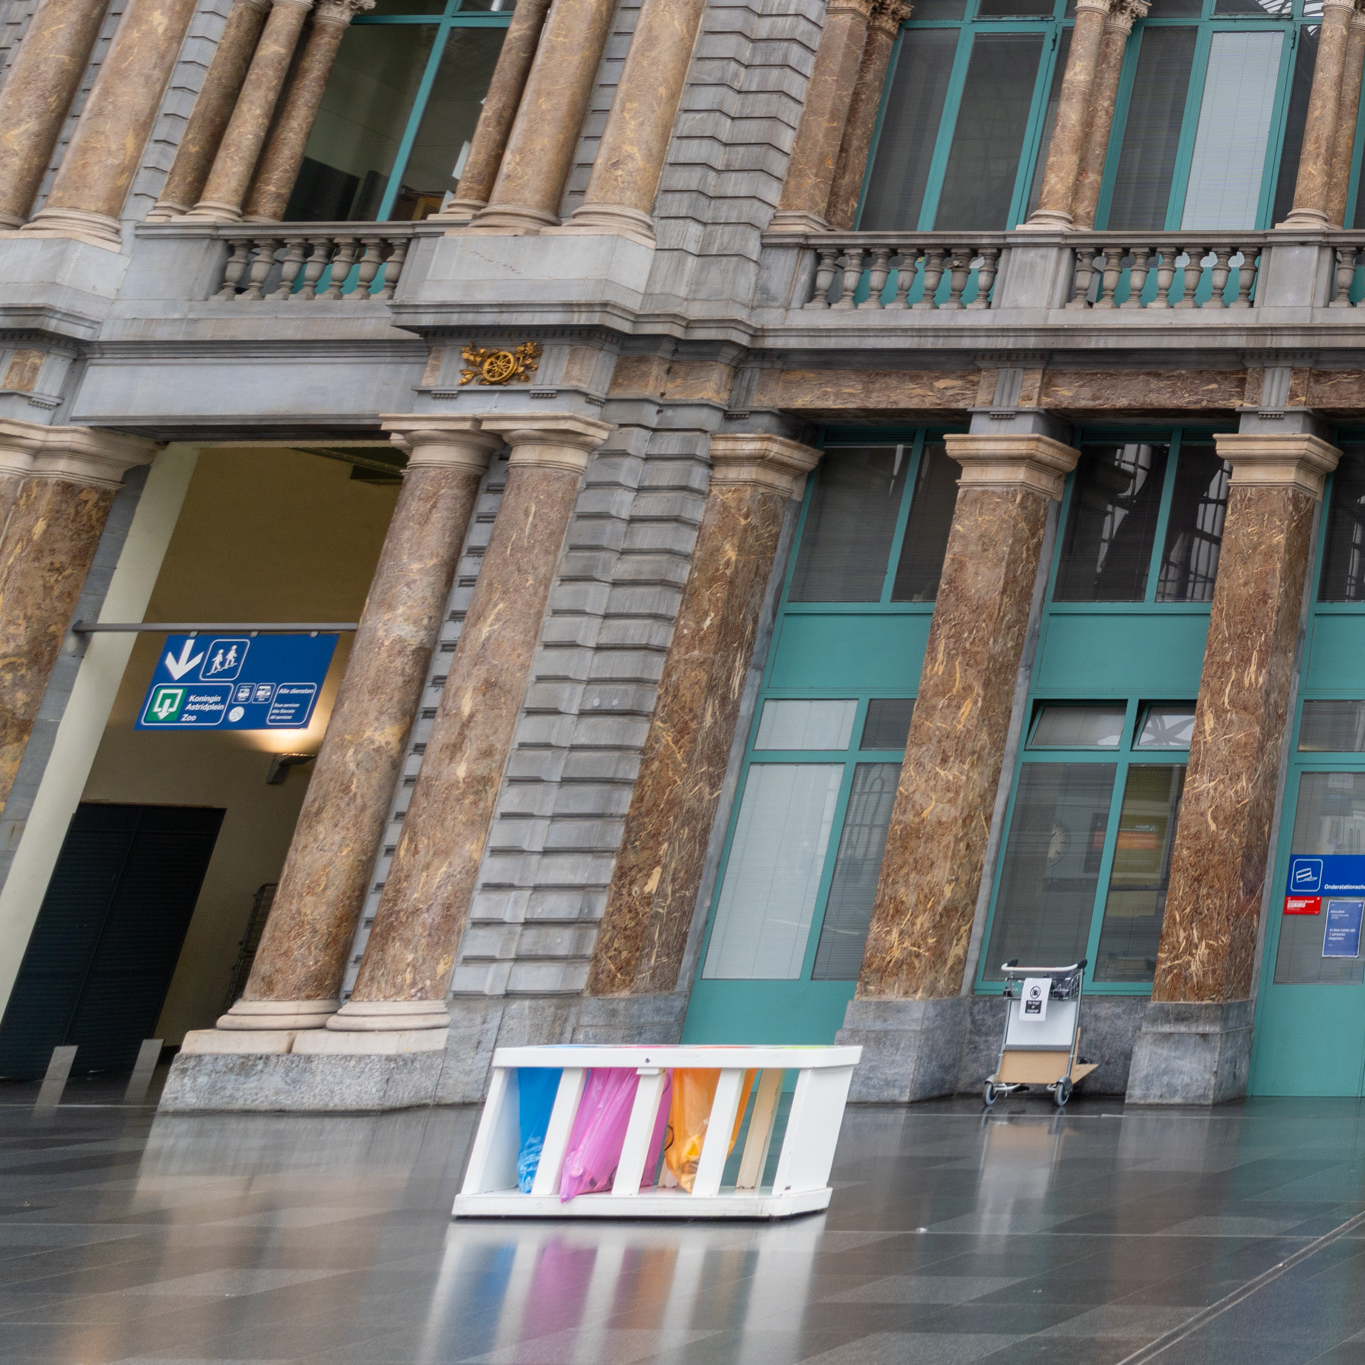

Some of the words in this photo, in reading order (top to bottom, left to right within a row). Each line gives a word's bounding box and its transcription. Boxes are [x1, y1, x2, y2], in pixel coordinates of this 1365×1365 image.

[189, 695, 221, 703] Koningin
[185, 703, 225, 712] Astridplein
[181, 713, 197, 722] Zoo
